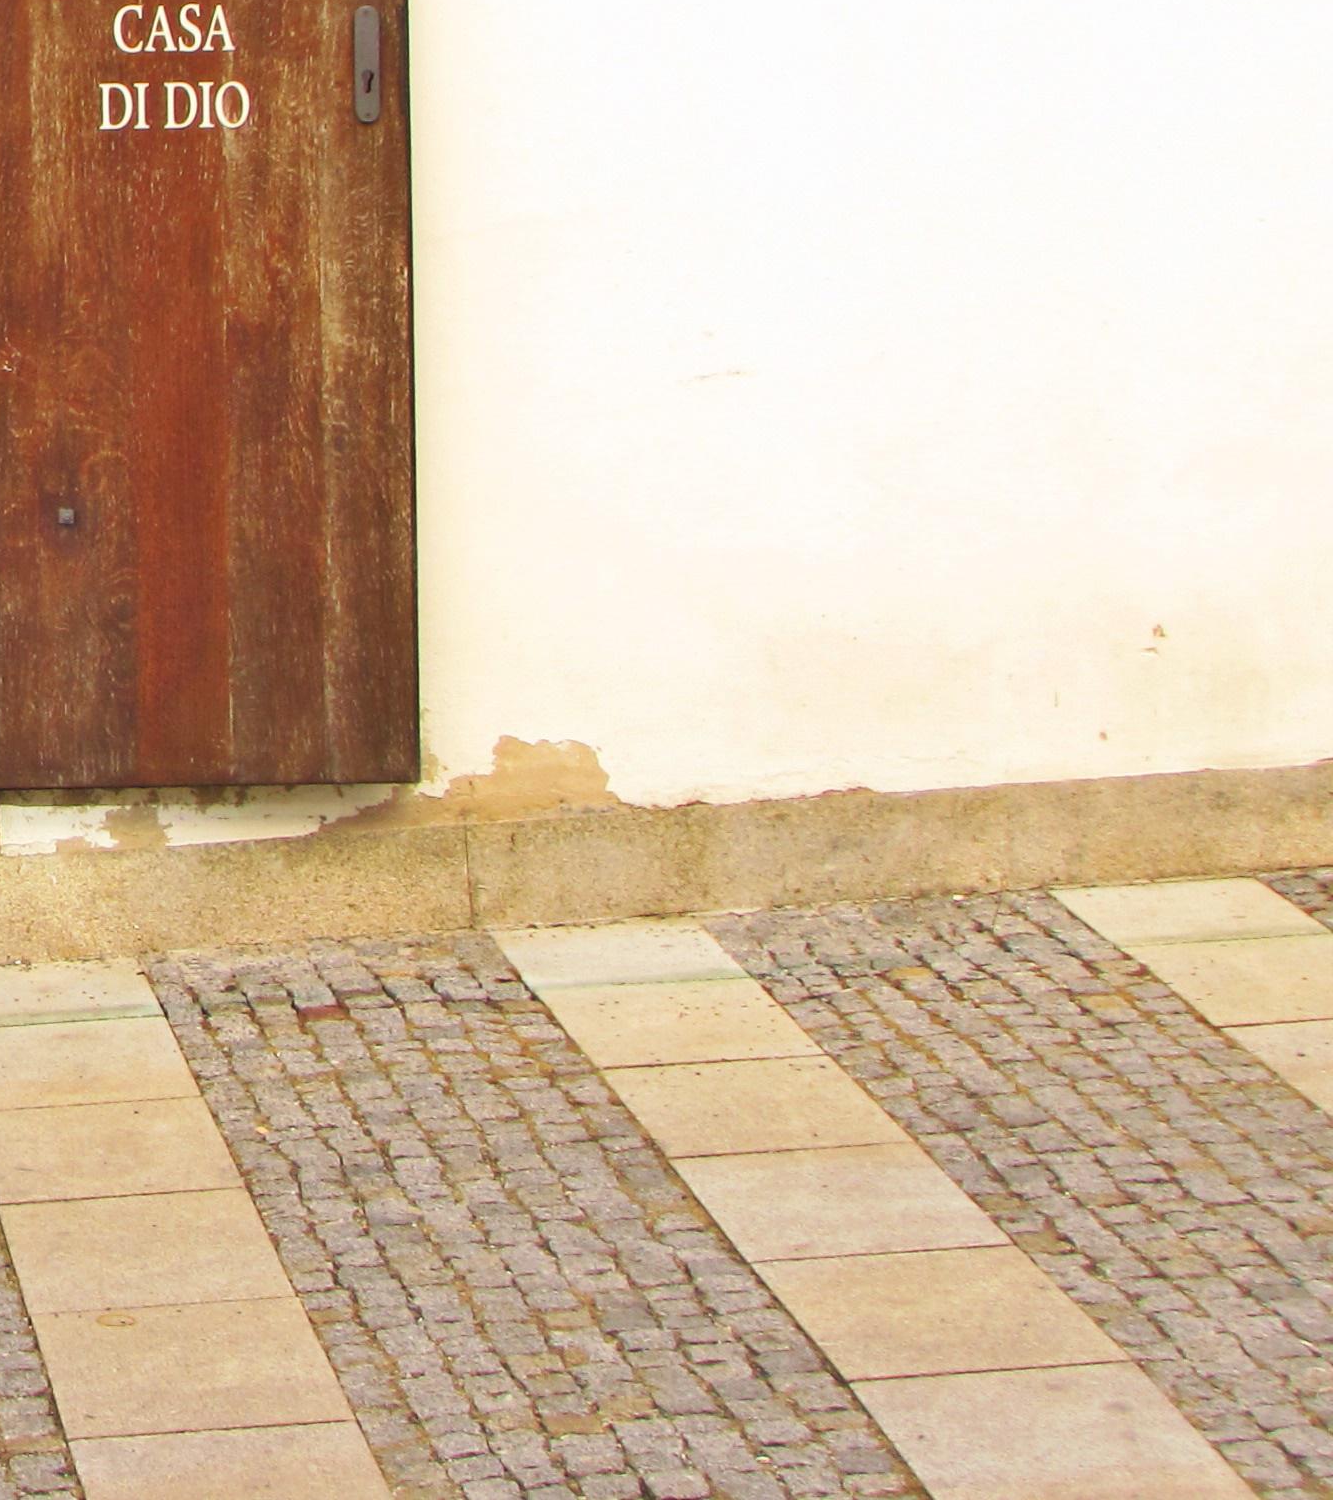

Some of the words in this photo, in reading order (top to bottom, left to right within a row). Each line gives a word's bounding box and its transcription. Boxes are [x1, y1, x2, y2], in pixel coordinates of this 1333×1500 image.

[113, 3, 236, 53] CASA
[99, 83, 150, 130] DI
[163, 81, 250, 130] DIO
